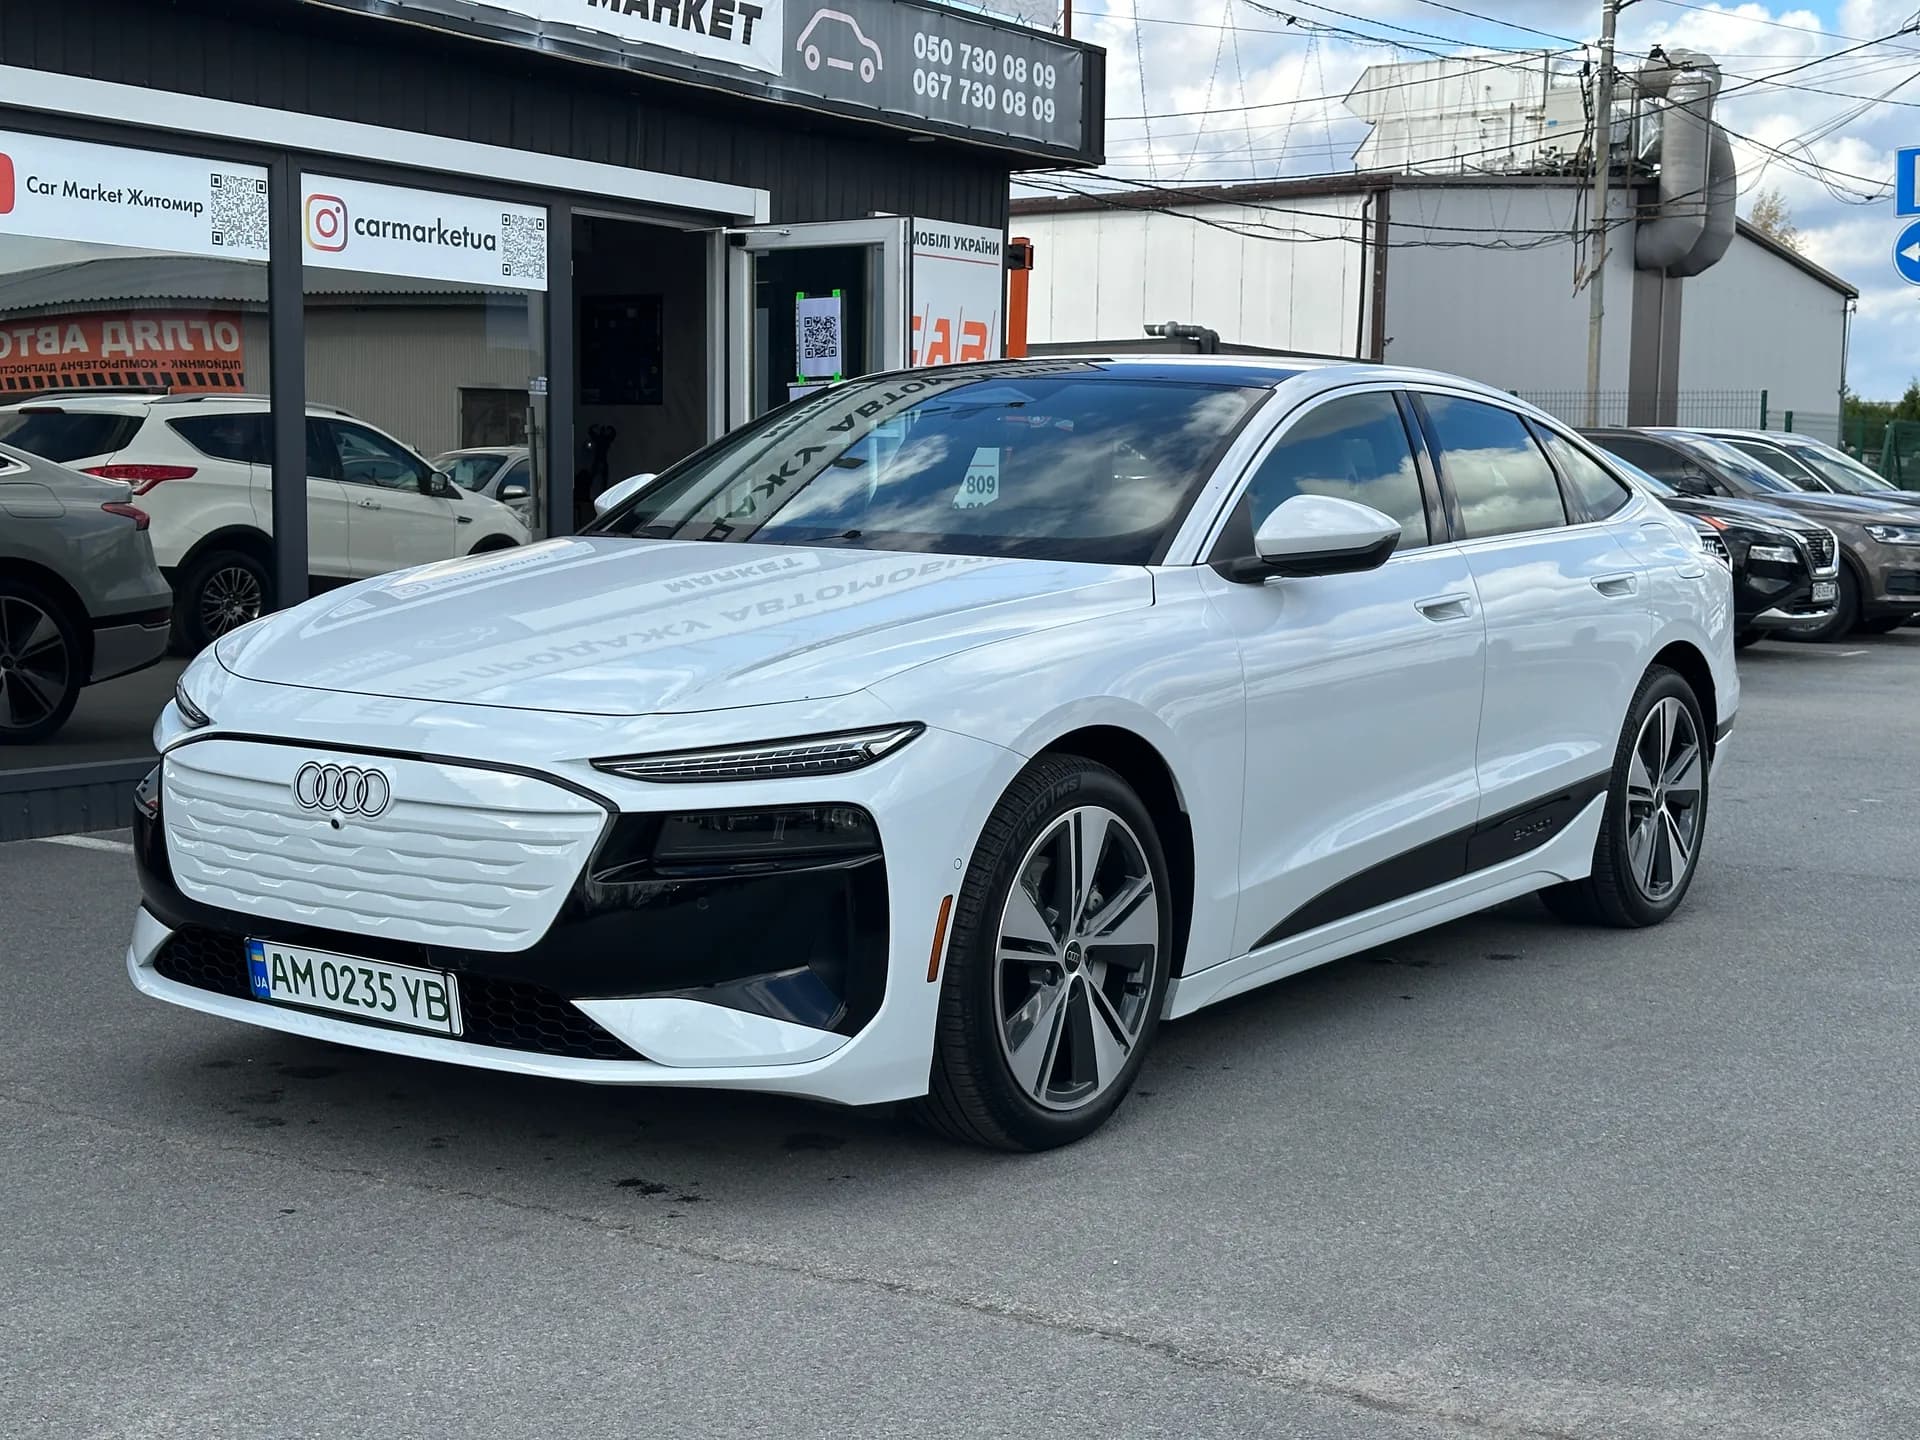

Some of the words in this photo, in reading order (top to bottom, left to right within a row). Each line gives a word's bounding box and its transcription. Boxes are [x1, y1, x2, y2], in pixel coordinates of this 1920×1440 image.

[587, 0, 763, 45] RKET
[913, 32, 953, 65] 050
[959, 43, 997, 76] 730
[1002, 54, 1027, 83] 08
[1032, 62, 1056, 90] 09
[913, 68, 952, 100] 067
[959, 78, 996, 110] 730
[1002, 88, 1026, 117] 08
[1032, 96, 1055, 123] 09
[26, 176, 57, 196] Car
[62, 180, 122, 204] Market
[127, 188, 204, 218] Житомир
[354, 217, 496, 251] carmarketua
[953, 236, 1000, 256] УКРАЇНИ
[912, 316, 987, 365] AR
[966, 475, 996, 494] 809
[254, 977, 269, 989] UA
